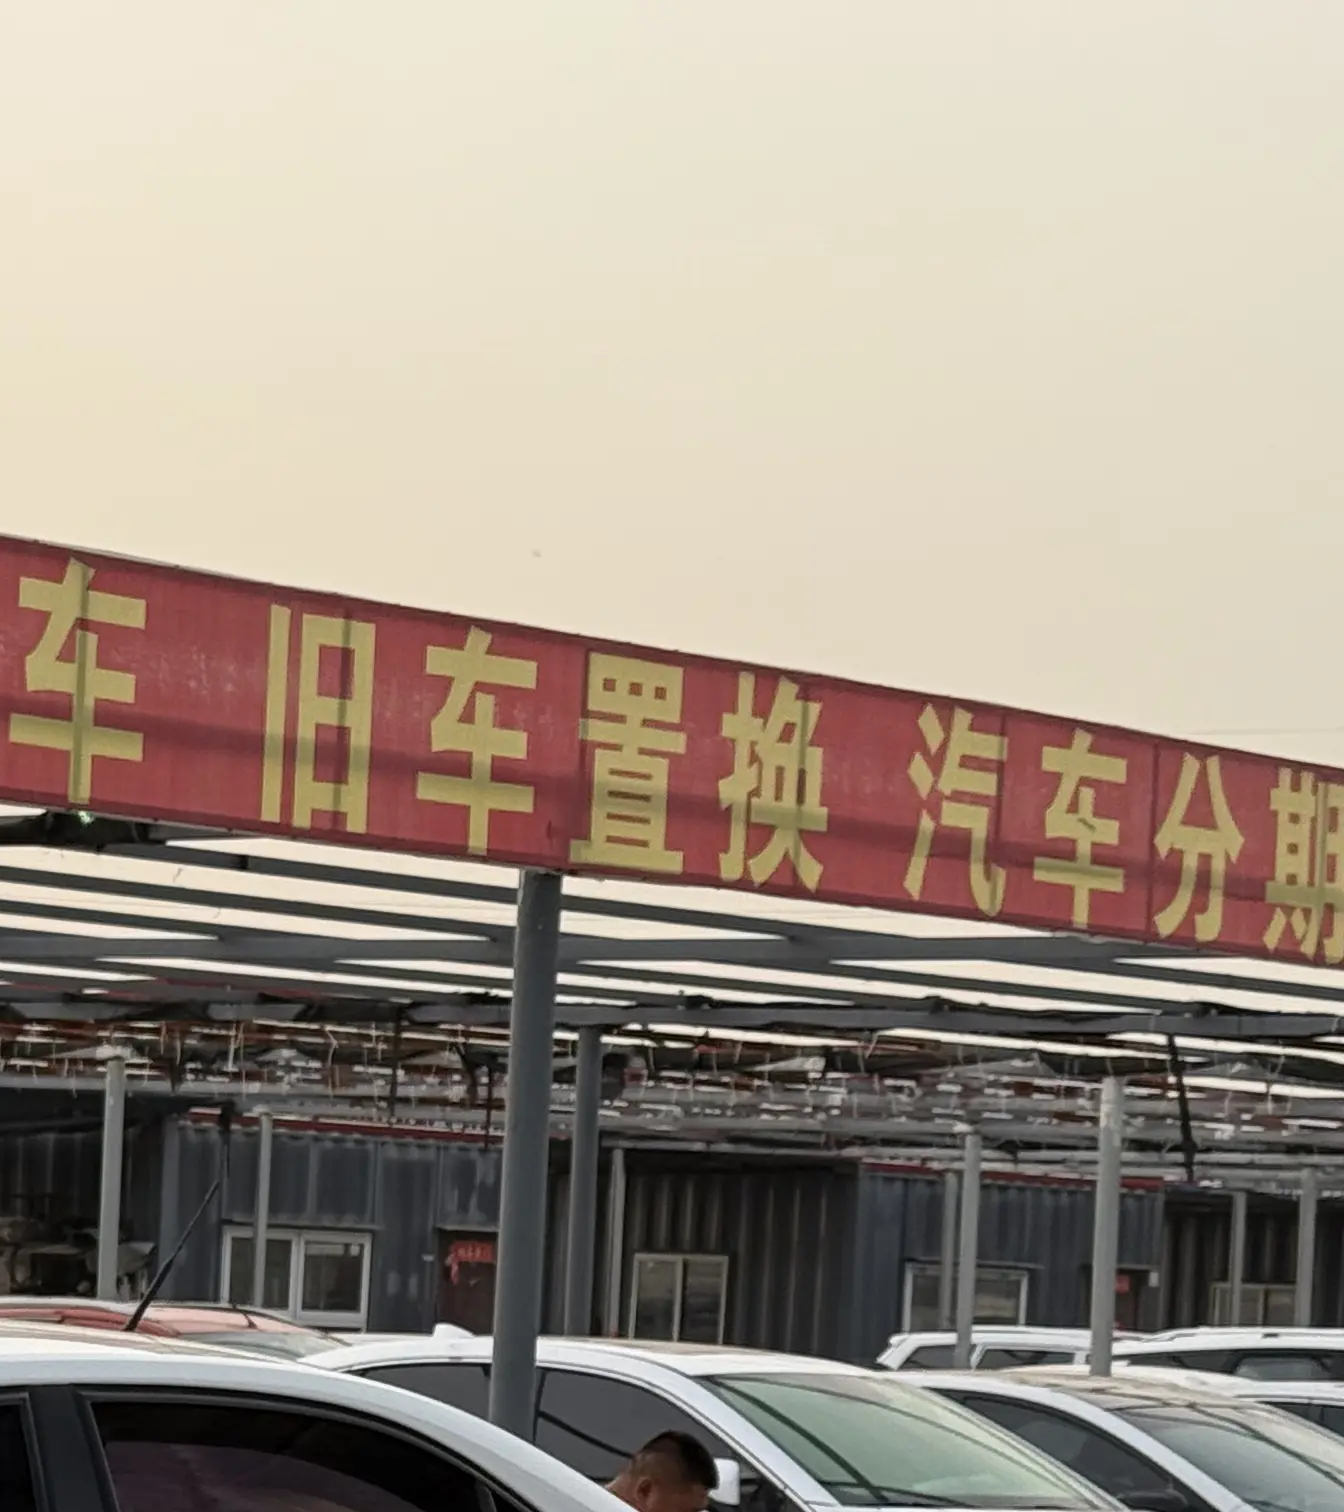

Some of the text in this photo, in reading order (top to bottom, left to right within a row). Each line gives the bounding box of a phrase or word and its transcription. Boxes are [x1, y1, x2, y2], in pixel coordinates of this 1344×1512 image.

[261, 604, 828, 892] 旧车置换
[903, 702, 1344, 965] 汽车分期
